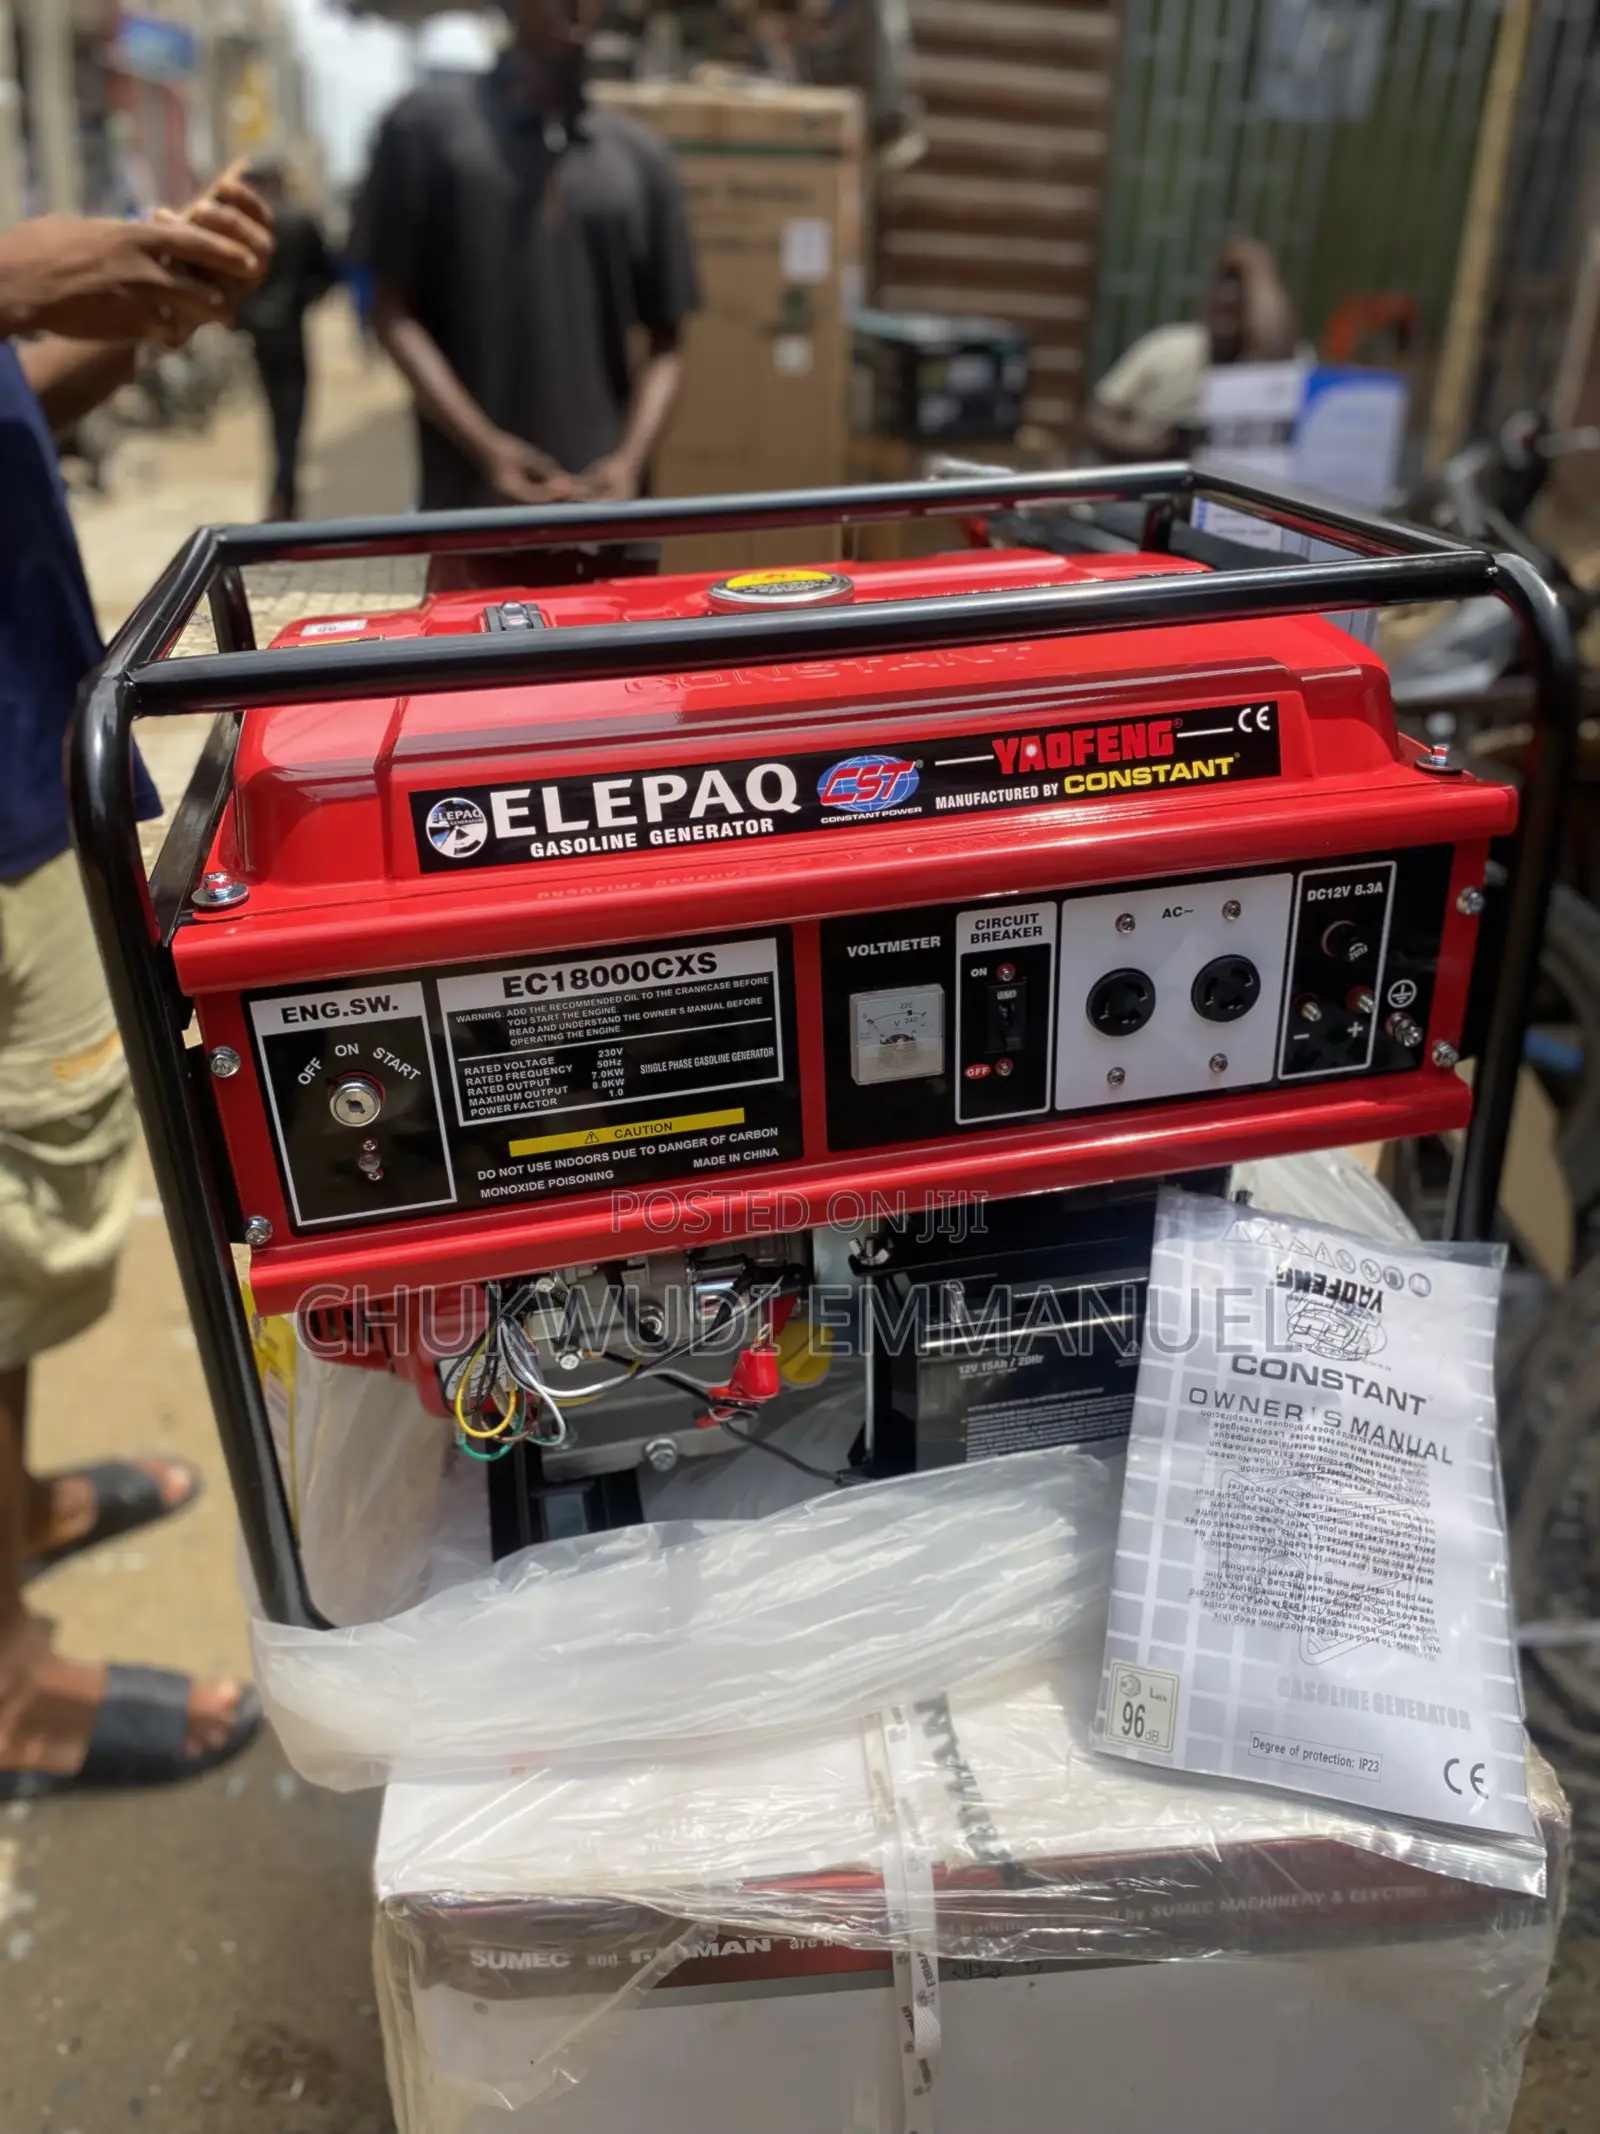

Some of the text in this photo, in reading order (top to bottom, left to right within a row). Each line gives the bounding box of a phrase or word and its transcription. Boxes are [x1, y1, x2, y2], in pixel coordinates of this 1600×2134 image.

[1237, 706, 1271, 733] CE
[992, 720, 1174, 774] YAOFENG
[935, 755, 1234, 810] MANUFACTURED BY CONSTANT
[490, 763, 801, 839] ELEPAQ
[820, 806, 922, 825] CONSTANT POWER
[530, 818, 774, 858] GASOLINE GENERATOR
[1307, 881, 1383, 901] DC12V 8.3A
[970, 925, 1043, 945] BREAKER
[975, 913, 1040, 931] CIRCUIT
[847, 936, 941, 957] VOLTMETER
[501, 950, 718, 999] EC18000CXS
[970, 967, 988, 977] ON
[281, 995, 398, 1025] ENG.SW.
[456, 976, 769, 1023] WARNING: ADD THE RECOMMENDED OIL TO THE CRANKCASE BEFORE
[507, 1005, 619, 1026] YOU START THE ENGINE.
[508, 996, 763, 1036] READ AND UNDERSTAND THE OWNER'S MANUAL BEFORE
[334, 1043, 360, 1056] ON
[510, 1025, 623, 1046] OPERATING THE ENGINE.
[297, 1057, 323, 1086] OFF
[373, 1047, 422, 1081] START
[463, 1047, 624, 1076] RATED VOLTAGE 230V
[465, 1057, 622, 1086] RATED FREQUENCY 50Hz
[639, 1046, 774, 1074] SINGLE PHASE GASOLINE GENERATOR
[966, 1066, 989, 1077] OFF
[467, 1067, 624, 1097] RATED OUTPUT 7.0KW
[468, 1077, 625, 1106] MAXIMUM OUTPUT 8.0KW
[469, 1088, 624, 1117] POWER FACTOR 1.0
[613, 1121, 673, 1139] CAUTION
[477, 1127, 778, 1180] DO NOT USE INDOORS DUE TO DANGER OF CARBON
[692, 1147, 779, 1168] MADE IN CHINA
[479, 1169, 614, 1198] MONOXIDE POISONING
[959, 1363, 978, 1376] 12V
[1018, 1354, 1044, 1366] 20Hr
[1231, 1354, 1427, 1416] CONSTANT
[1189, 1387, 1342, 1429] OWNER'S
[1350, 1417, 1453, 1465] MANUAL
[1277, 1676, 1472, 1732] GASOLINE GENERATOR
[1121, 1701, 1159, 1742] 96 dB
[1252, 1736, 1380, 1773] Degree of protection: IP23
[1444, 1757, 1489, 1799] CE
[471, 1950, 572, 1970] SUMEC
[789, 1936, 817, 1950] are
